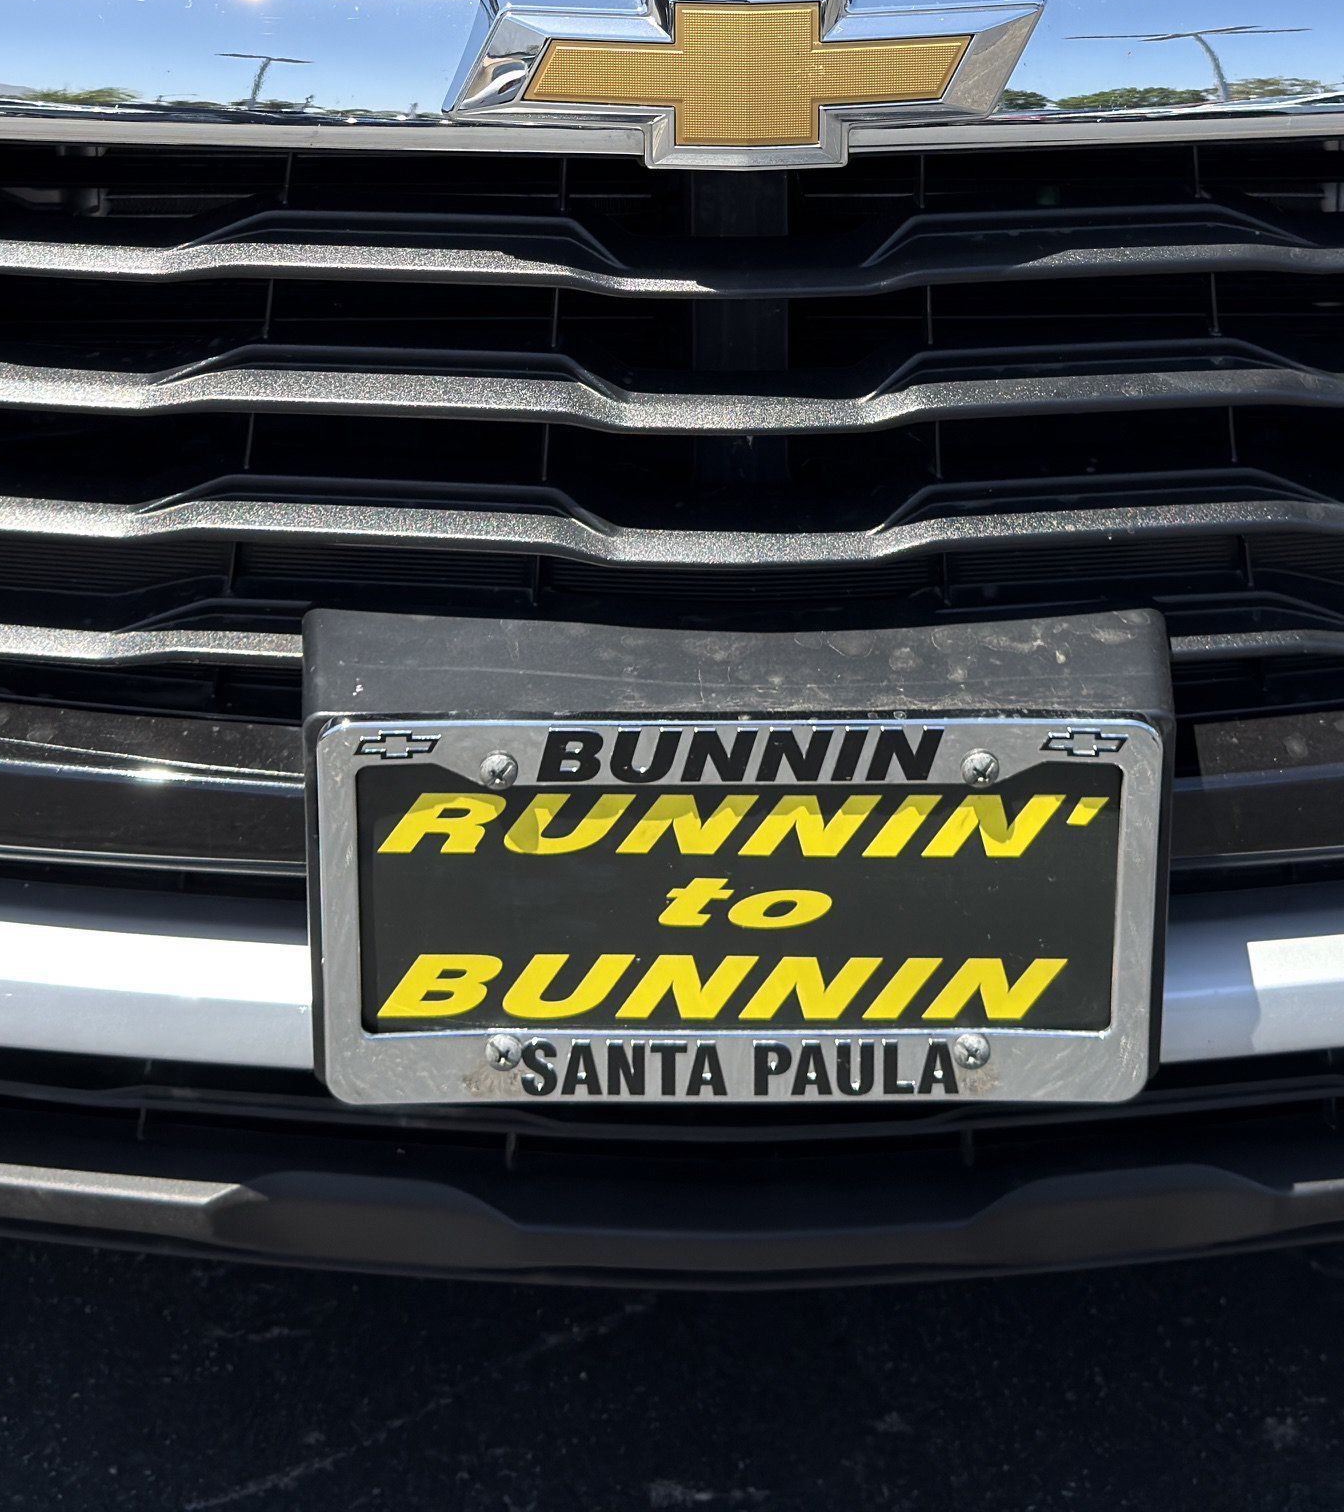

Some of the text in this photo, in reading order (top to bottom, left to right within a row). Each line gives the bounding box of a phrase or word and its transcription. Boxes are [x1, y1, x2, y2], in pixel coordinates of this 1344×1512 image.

[536, 727, 946, 784] BUNNIN
[376, 793, 1110, 859] RUNNIN'
[657, 877, 833, 930] to
[376, 954, 1069, 1022] BUNNIN
[521, 1039, 960, 1099] SANTA PAULA
